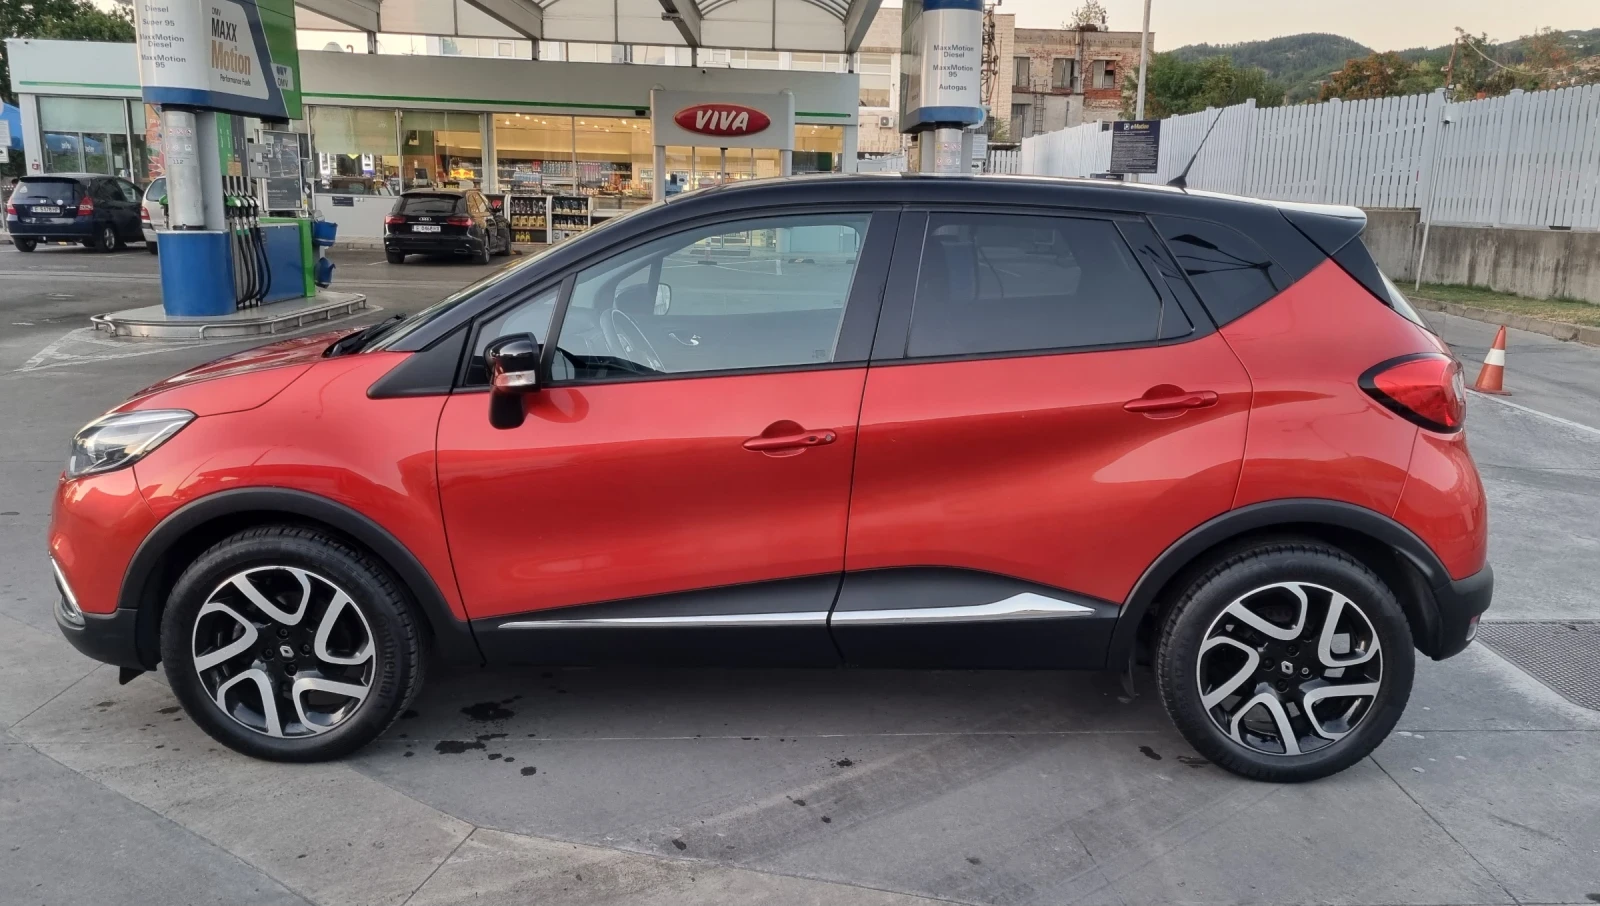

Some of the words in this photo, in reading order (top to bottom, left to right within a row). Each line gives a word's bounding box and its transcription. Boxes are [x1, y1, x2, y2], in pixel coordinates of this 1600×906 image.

[211, 17, 237, 42] MAXX
[147, 40, 172, 48] Diesel
[211, 39, 251, 75] Motion
[220, 73, 241, 84] Performance
[695, 109, 749, 132] VIVA
